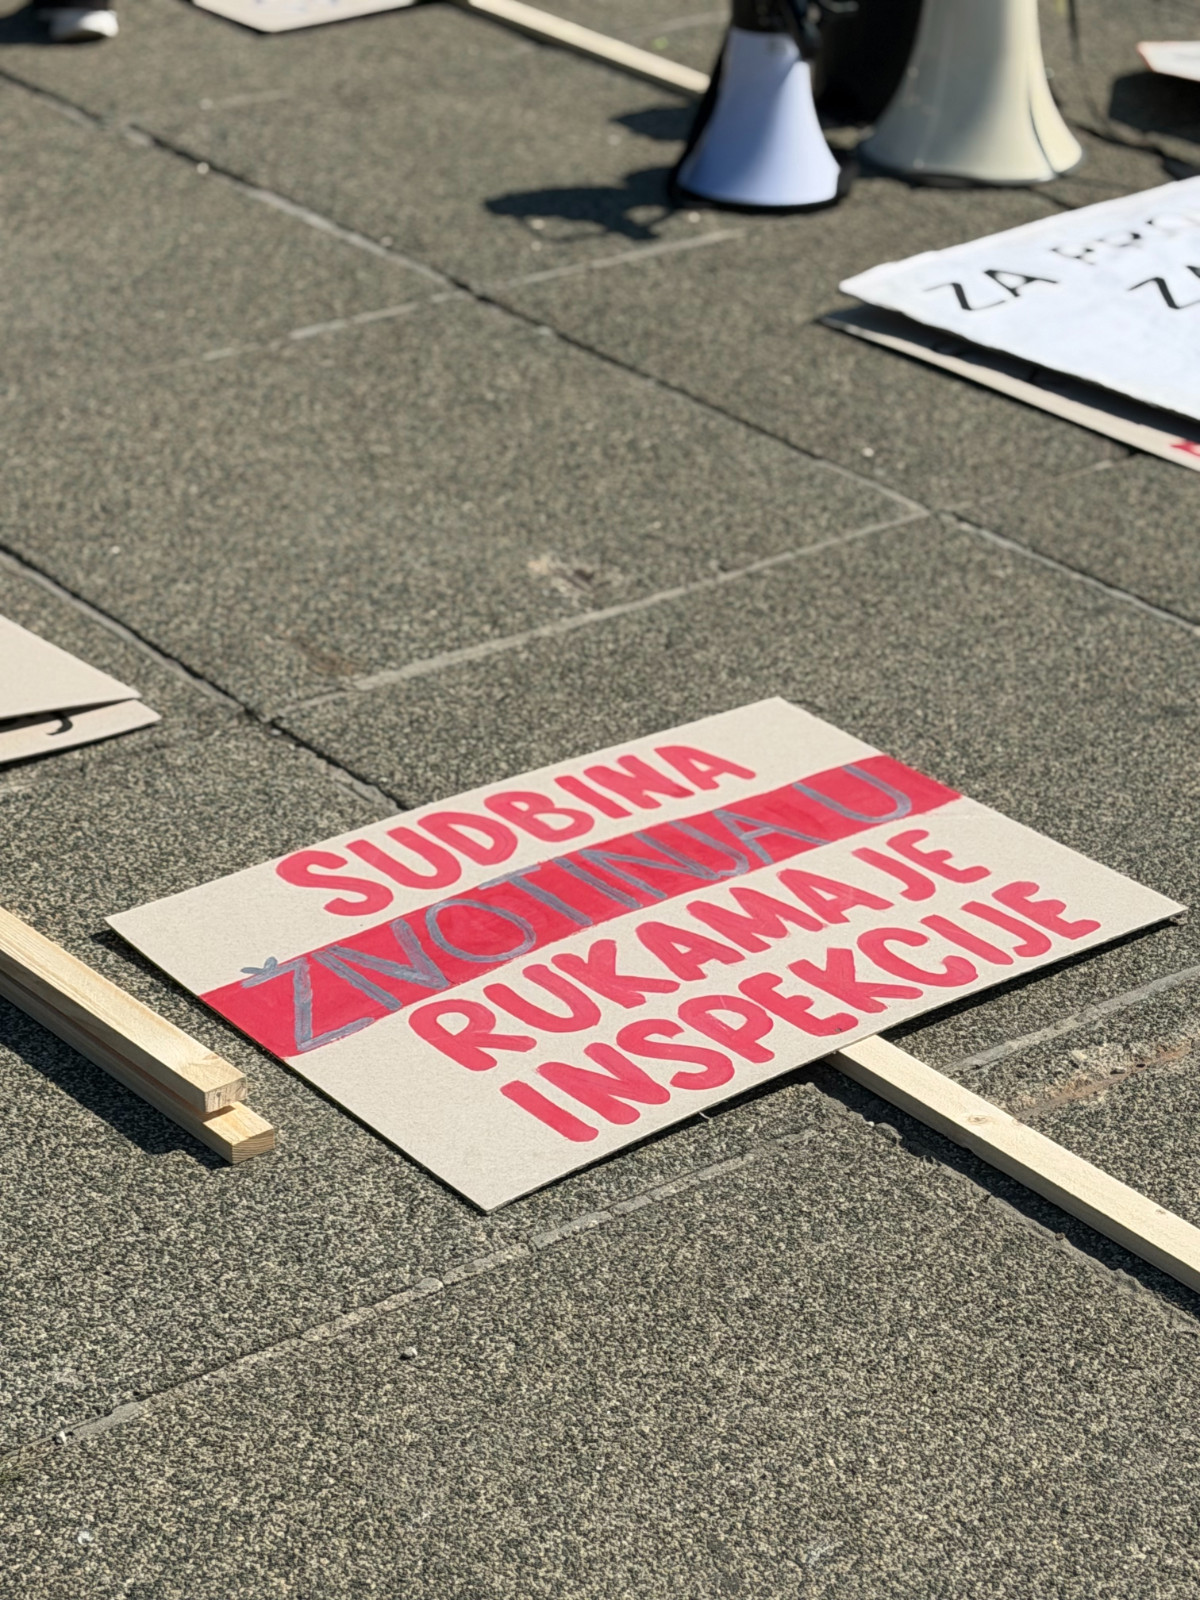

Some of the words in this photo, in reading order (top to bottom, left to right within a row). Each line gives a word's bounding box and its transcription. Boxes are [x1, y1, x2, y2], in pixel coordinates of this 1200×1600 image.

[923, 269, 1059, 312] ZA
[1126, 265, 1200, 310] Z
[240, 808, 830, 1053] ŽIVOTINJA
[793, 763, 913, 823] U
[275, 744, 756, 917] SUDBINA
[408, 867, 895, 1072] RUKAMA
[851, 828, 993, 902] JE
[499, 880, 1102, 1143] INSPEKCIJE
